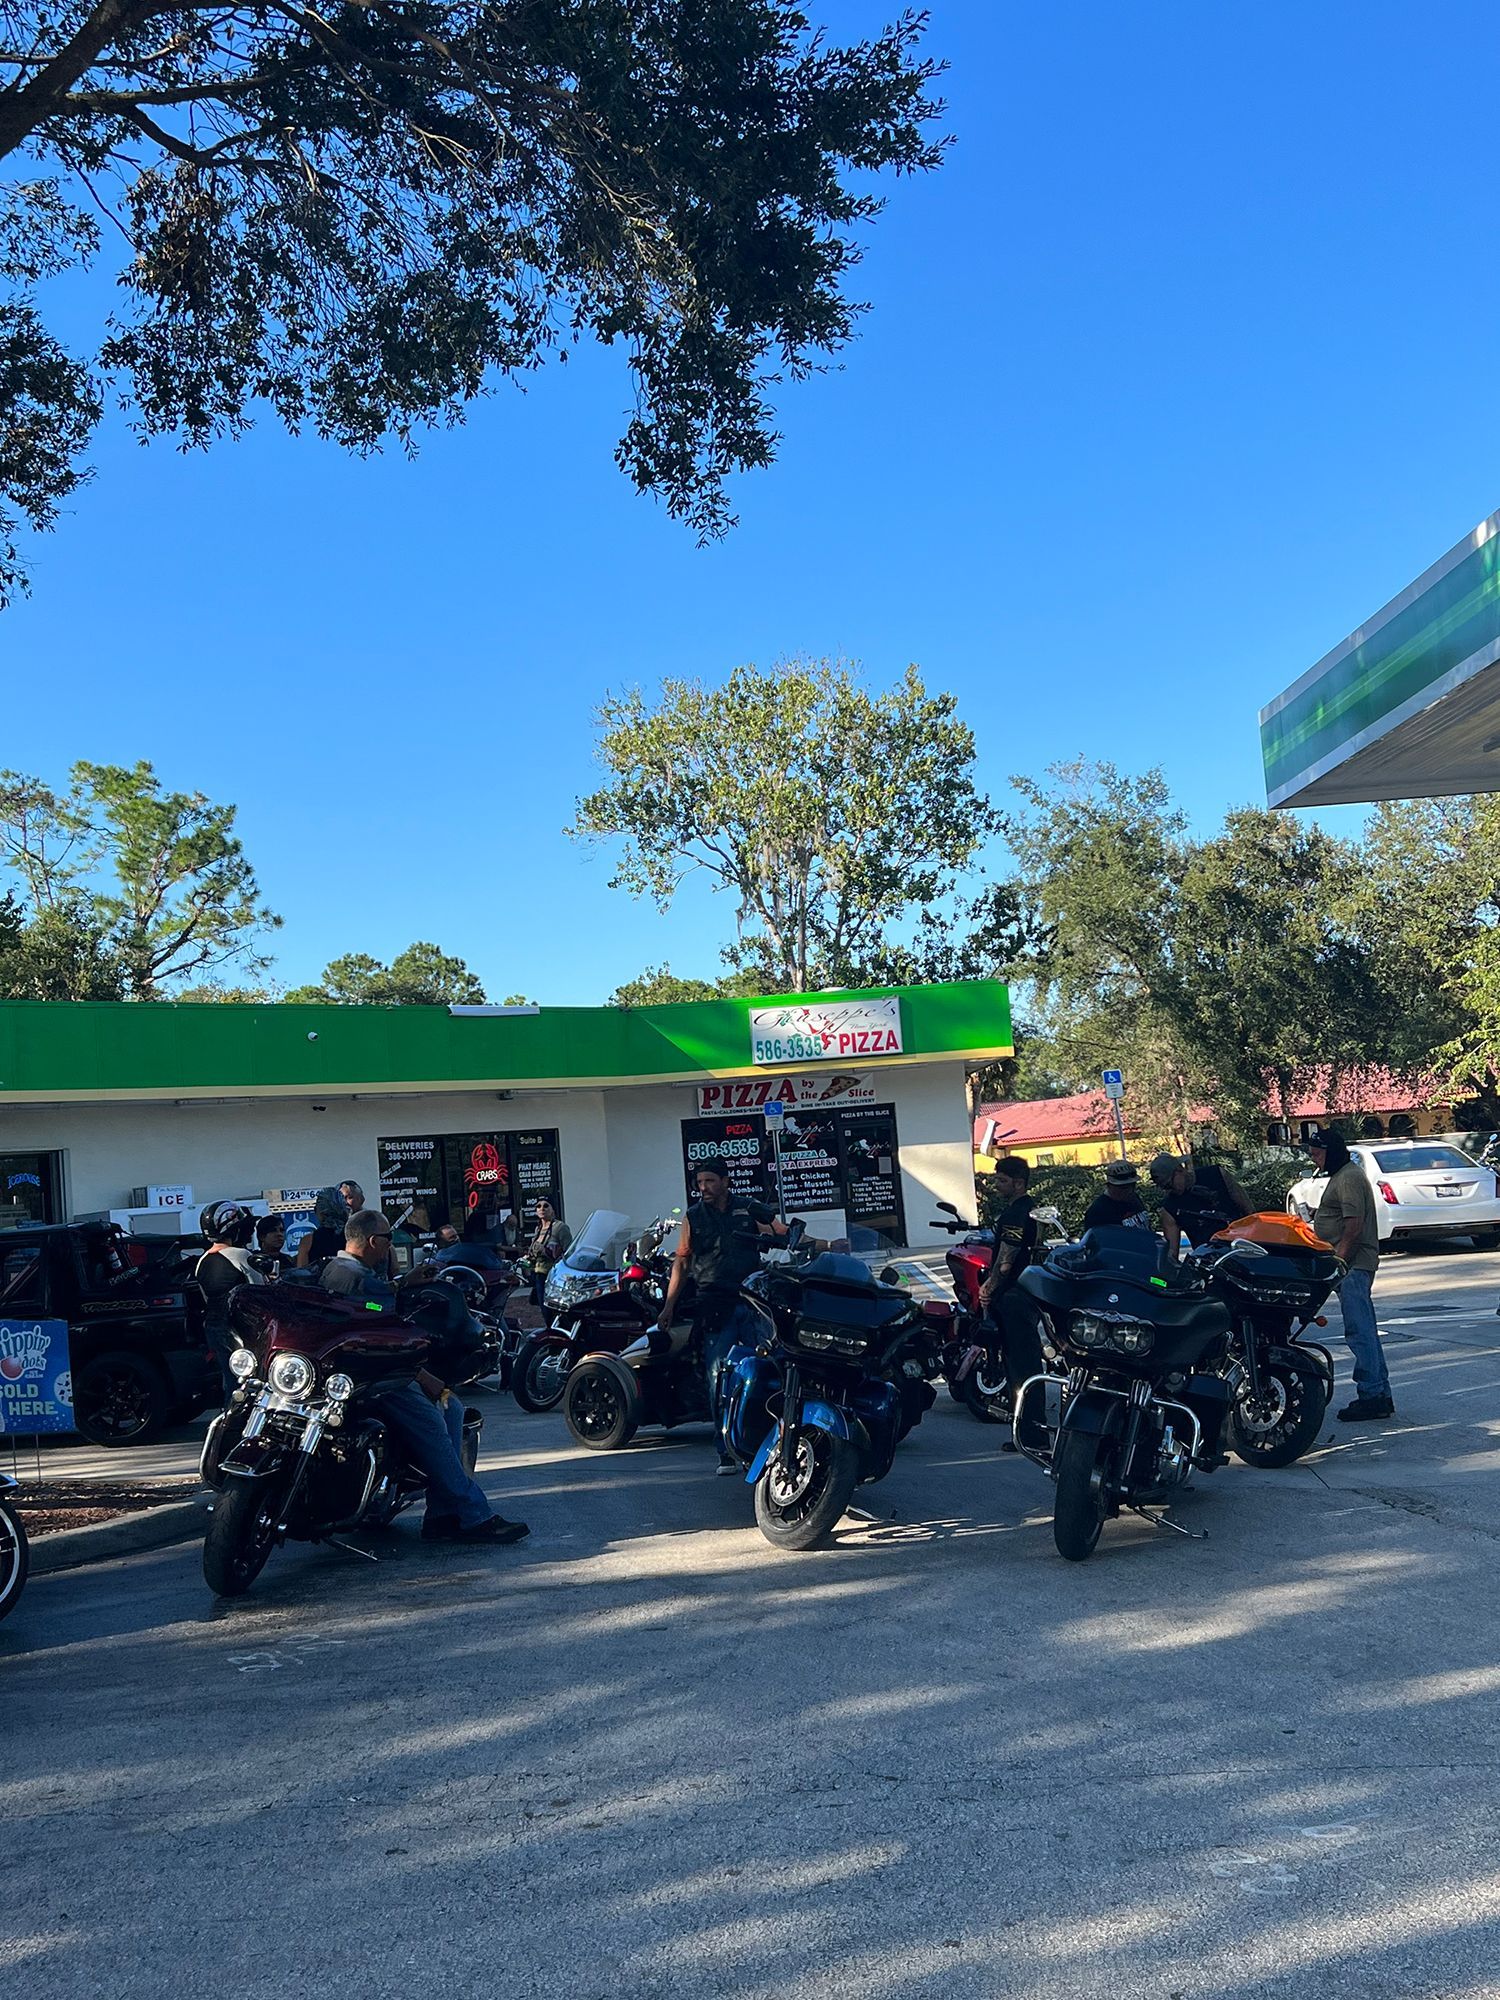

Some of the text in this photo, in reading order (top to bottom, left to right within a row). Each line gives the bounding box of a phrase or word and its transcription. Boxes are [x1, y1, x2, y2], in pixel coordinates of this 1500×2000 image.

[839, 1030, 899, 1054] PIZZA
[756, 1036, 822, 1061] 586-3535
[802, 1079, 815, 1089] by
[701, 1078, 798, 1110] PIZZA
[801, 1088, 874, 1100] the Slice
[726, 1124, 753, 1135] PIZZA
[385, 1141, 434, 1151] DELIVERIES
[520, 1137, 536, 1145] Suite
[688, 1138, 759, 1160] 586-3535
[791, 1150, 818, 1160] PIZZA
[819, 1149, 827, 1158] &
[740, 1158, 761, 1166] Close
[768, 1157, 838, 1171] PSTA EXPRESS
[476, 1169, 498, 1181] CRABS
[800, 1172, 830, 1180] Chicken
[804, 1180, 834, 1188] Mussels
[783, 1188, 833, 1198] ourmet Pasta
[159, 1194, 184, 1206] ICE
[804, 1197, 833, 1205] Dinners
[0, 1325, 51, 1358] ippin'
[22, 1356, 46, 1370] dots
[9, 1401, 58, 1415] HERE
